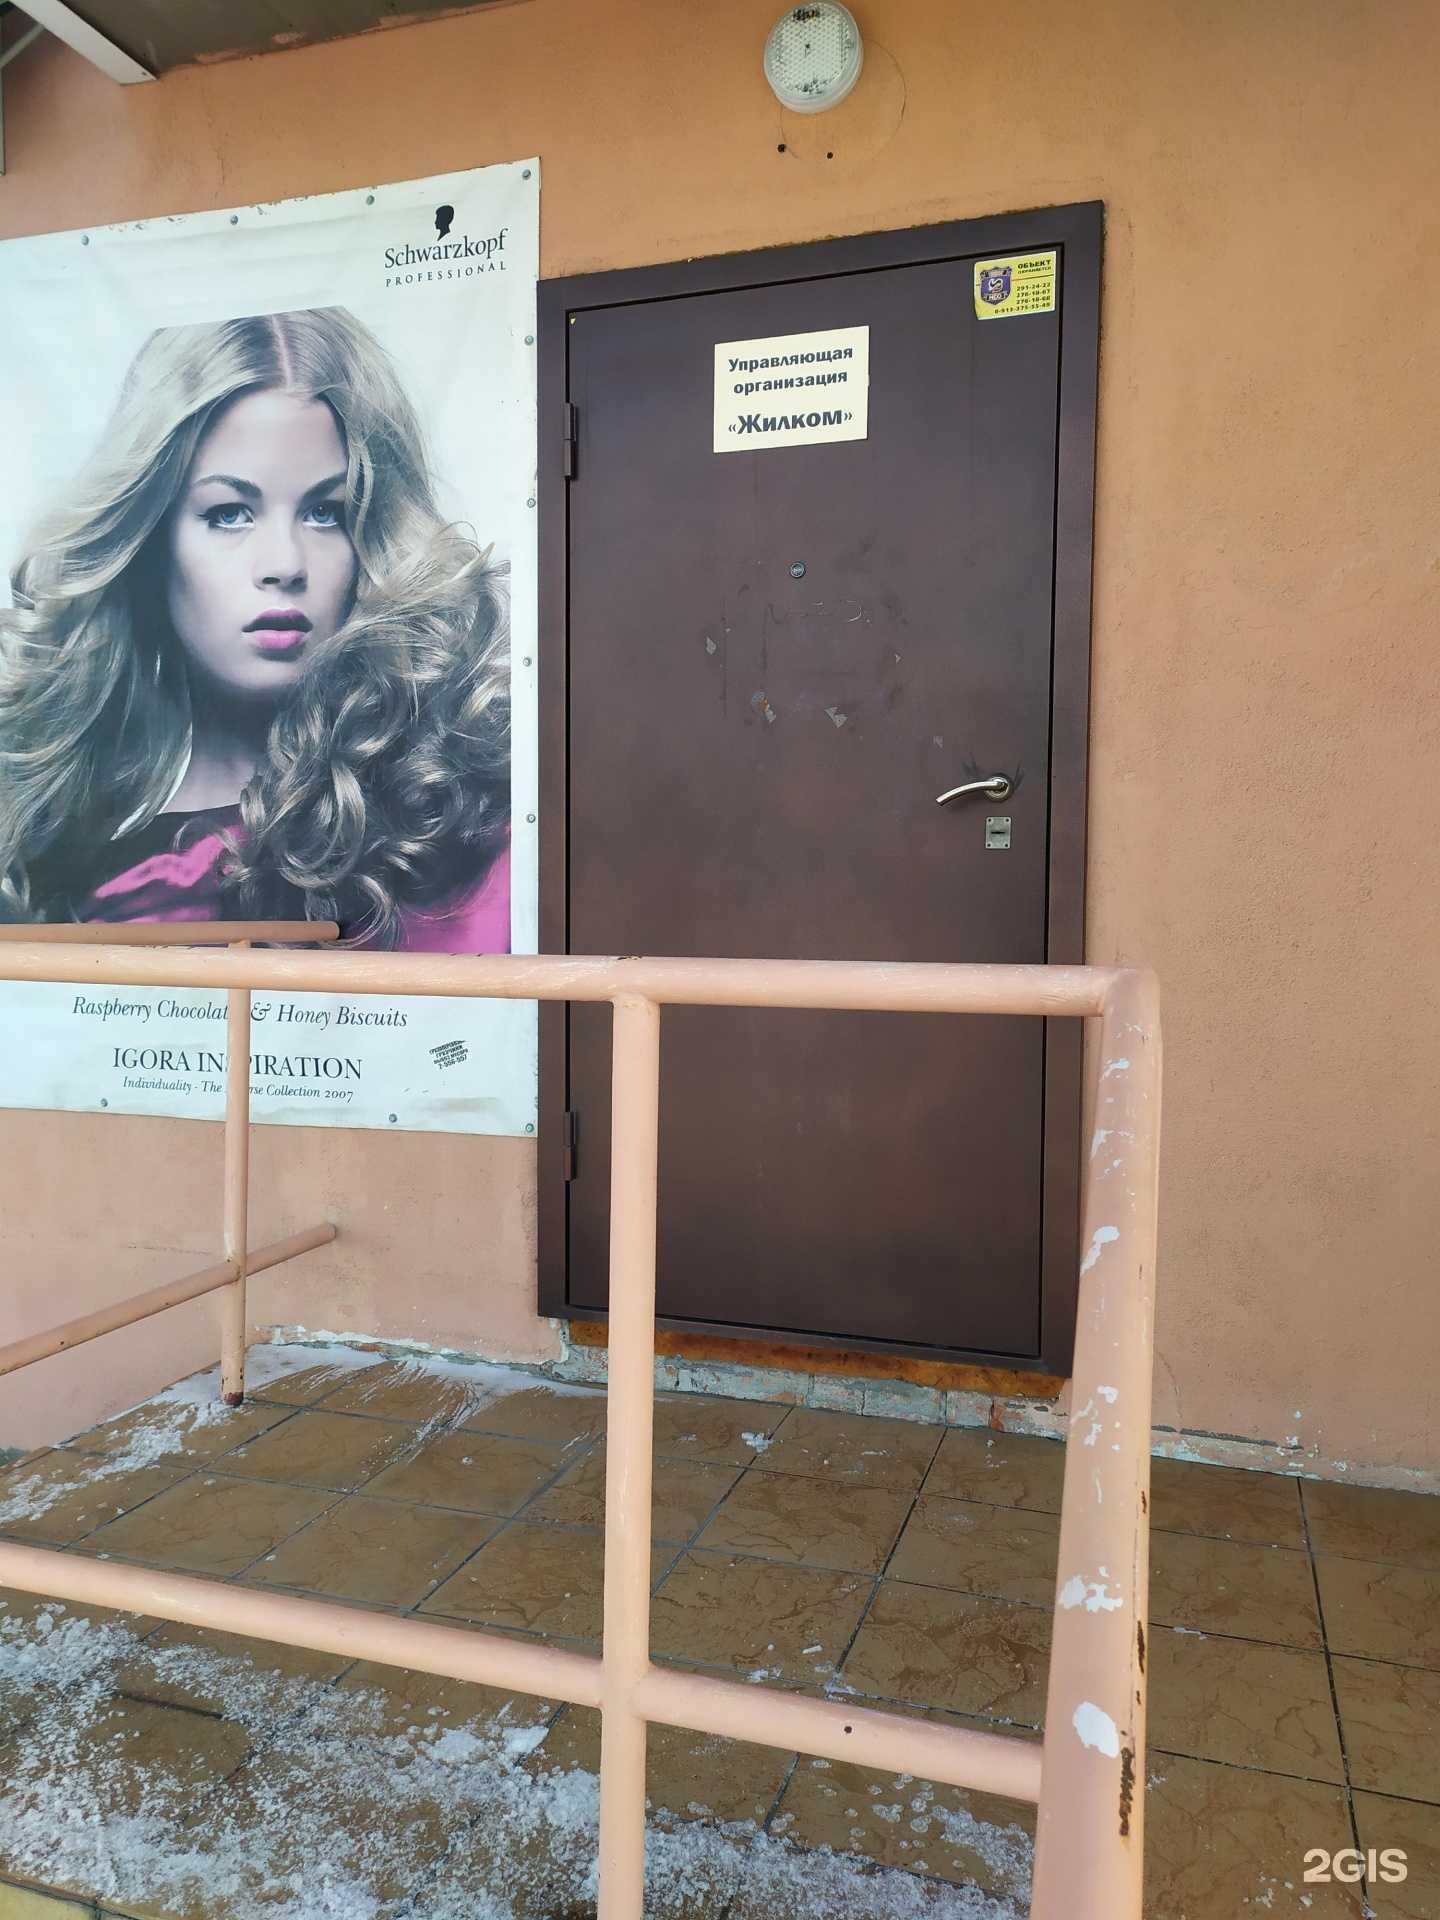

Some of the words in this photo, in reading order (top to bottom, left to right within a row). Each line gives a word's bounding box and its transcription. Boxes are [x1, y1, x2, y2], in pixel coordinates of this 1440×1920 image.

[384, 228, 508, 269] Schwarzkopf
[385, 261, 507, 287] PROFESSIONAL
[1017, 259, 1051, 269] ОБЪЕКТ
[728, 347, 853, 372] Управляющая
[733, 371, 848, 396] организация
[728, 410, 853, 434] «Жилком»
[72, 996, 151, 1023] Raspberry
[157, 999, 229, 1020] Chocolat
[250, 1001, 272, 1022] &
[276, 1004, 331, 1031] Honey
[335, 1006, 408, 1027] Biscuits
[112, 1047, 192, 1072] IGORA
[197, 1051, 363, 1079] INIRATION
[123, 1076, 192, 1095] Individuality
[201, 1080, 223, 1093] The
[266, 1084, 321, 1097] Collection
[324, 1089, 354, 1103] 2007
